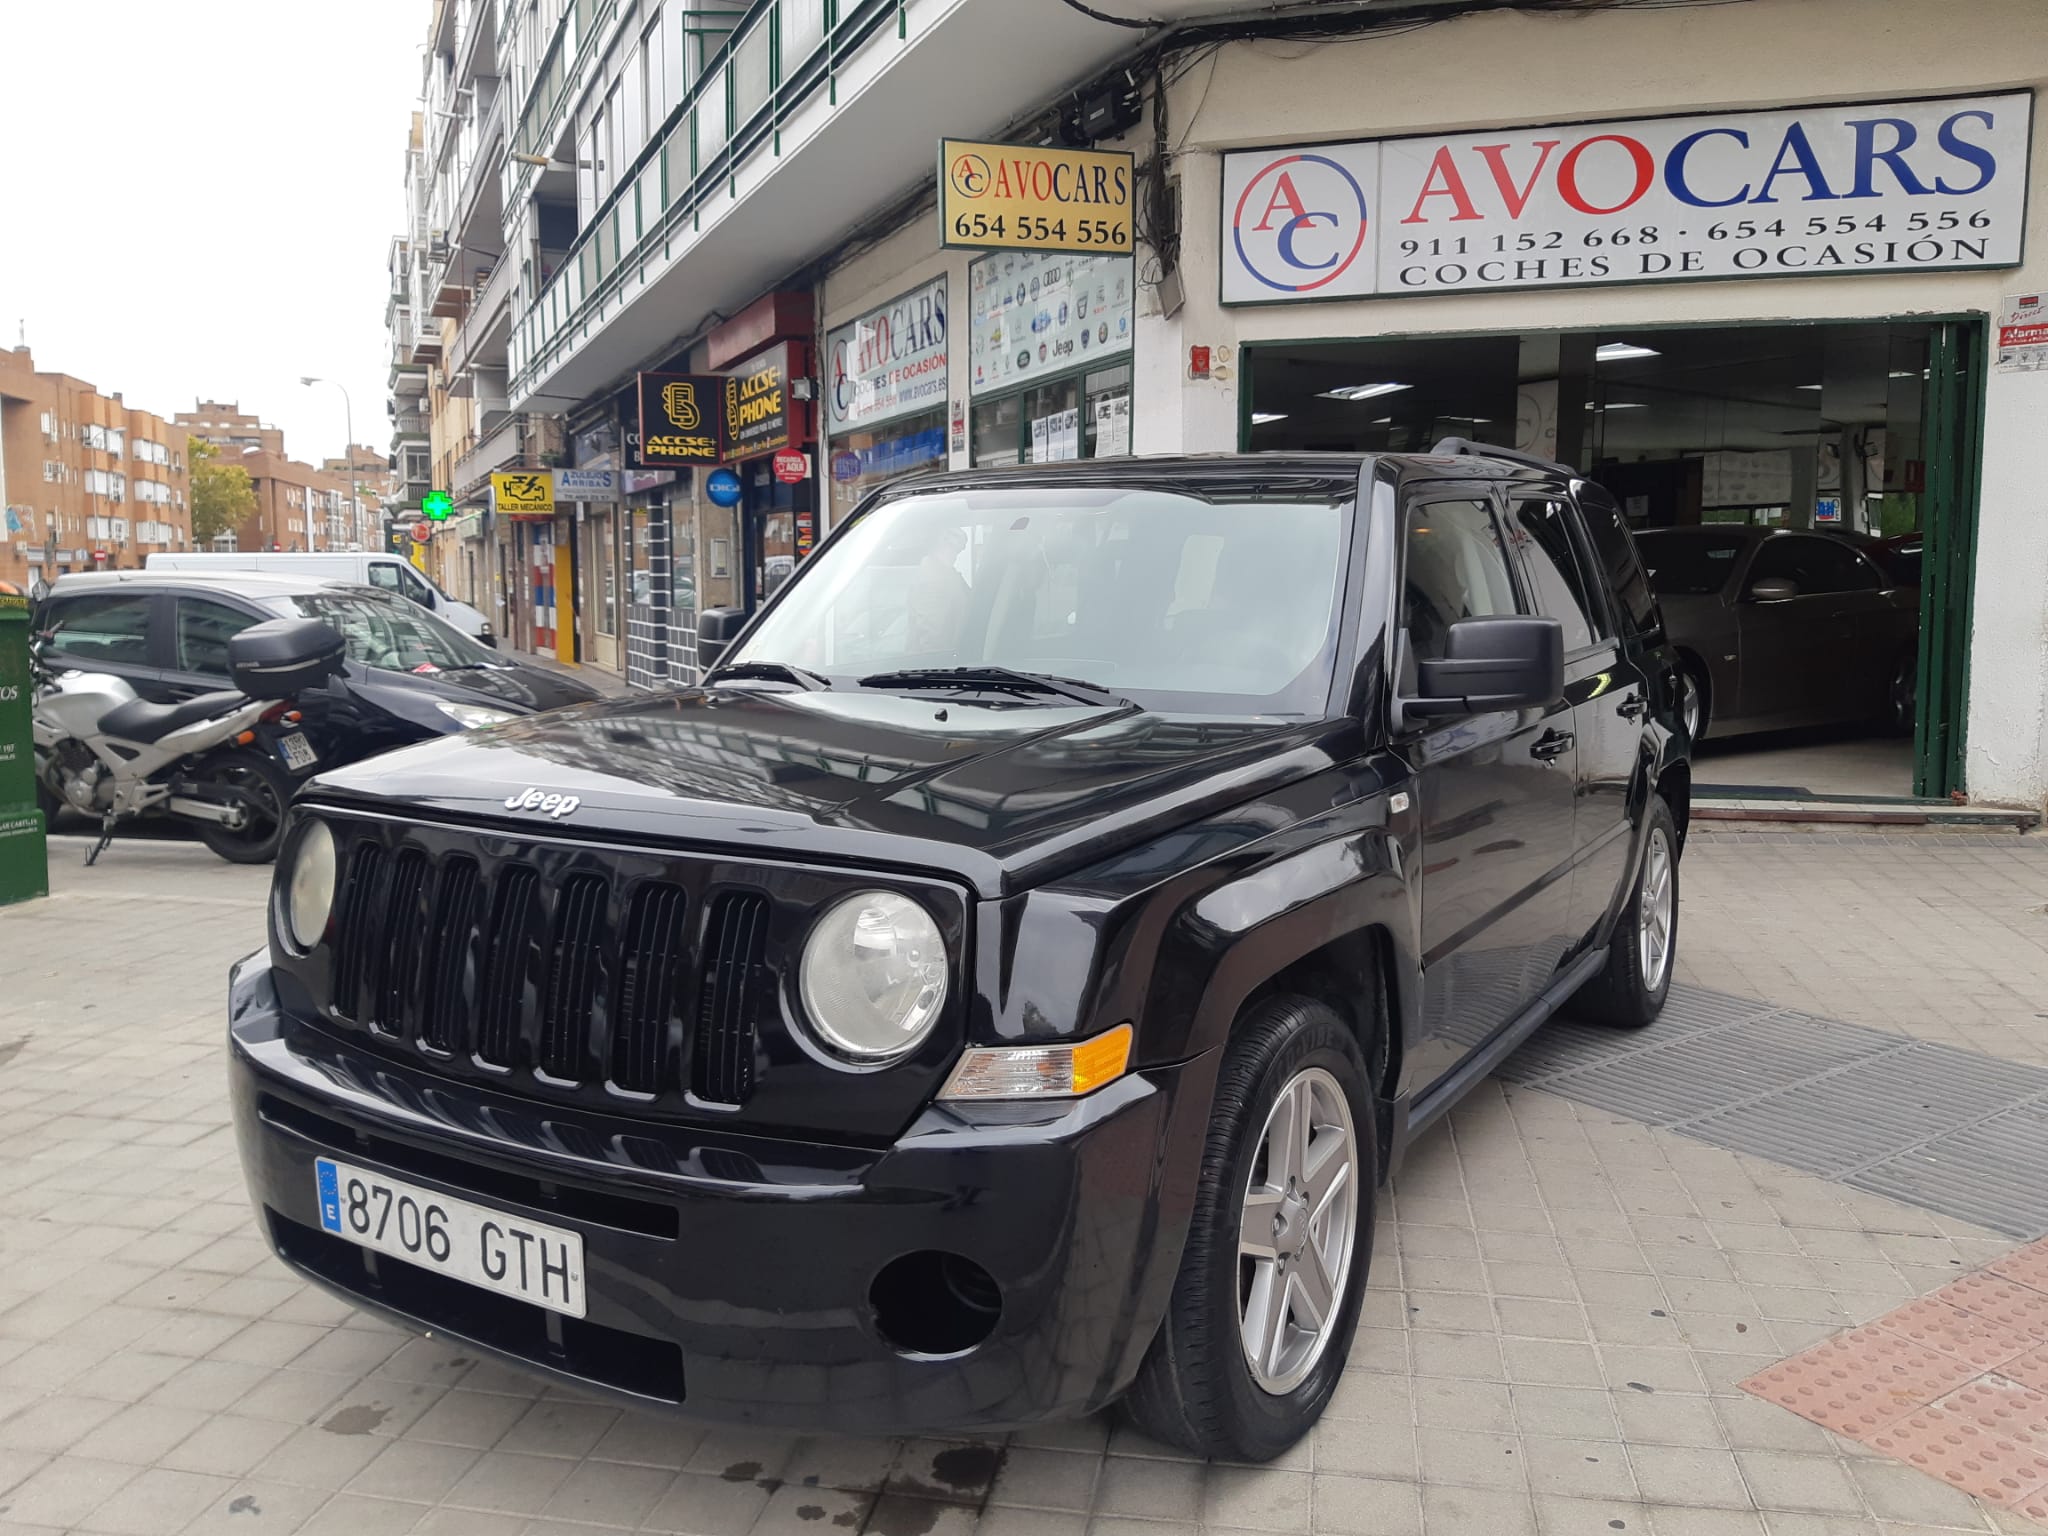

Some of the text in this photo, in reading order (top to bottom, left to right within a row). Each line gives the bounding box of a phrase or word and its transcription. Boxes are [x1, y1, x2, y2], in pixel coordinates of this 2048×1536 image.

[994, 159, 1127, 206] AVOCARS
[1400, 110, 1997, 224] AVOCARS
[955, 212, 1127, 246] 654 554 556
[1400, 209, 1991, 258] 911 152 668 654 554 556
[1400, 234, 1990, 287] COCHES DE OCASIÓN
[1053, 339, 1074, 357] Jeep
[740, 365, 782, 401] ACCSE+
[903, 352, 947, 380] OCASIÓN
[739, 390, 782, 427] PHONE
[646, 445, 716, 457] PHONE
[647, 435, 717, 446] ACCSE+
[709, 484, 740, 492] DIGI
[504, 787, 581, 819] Jeep
[327, 1178, 569, 1304] E 8706 GTH
